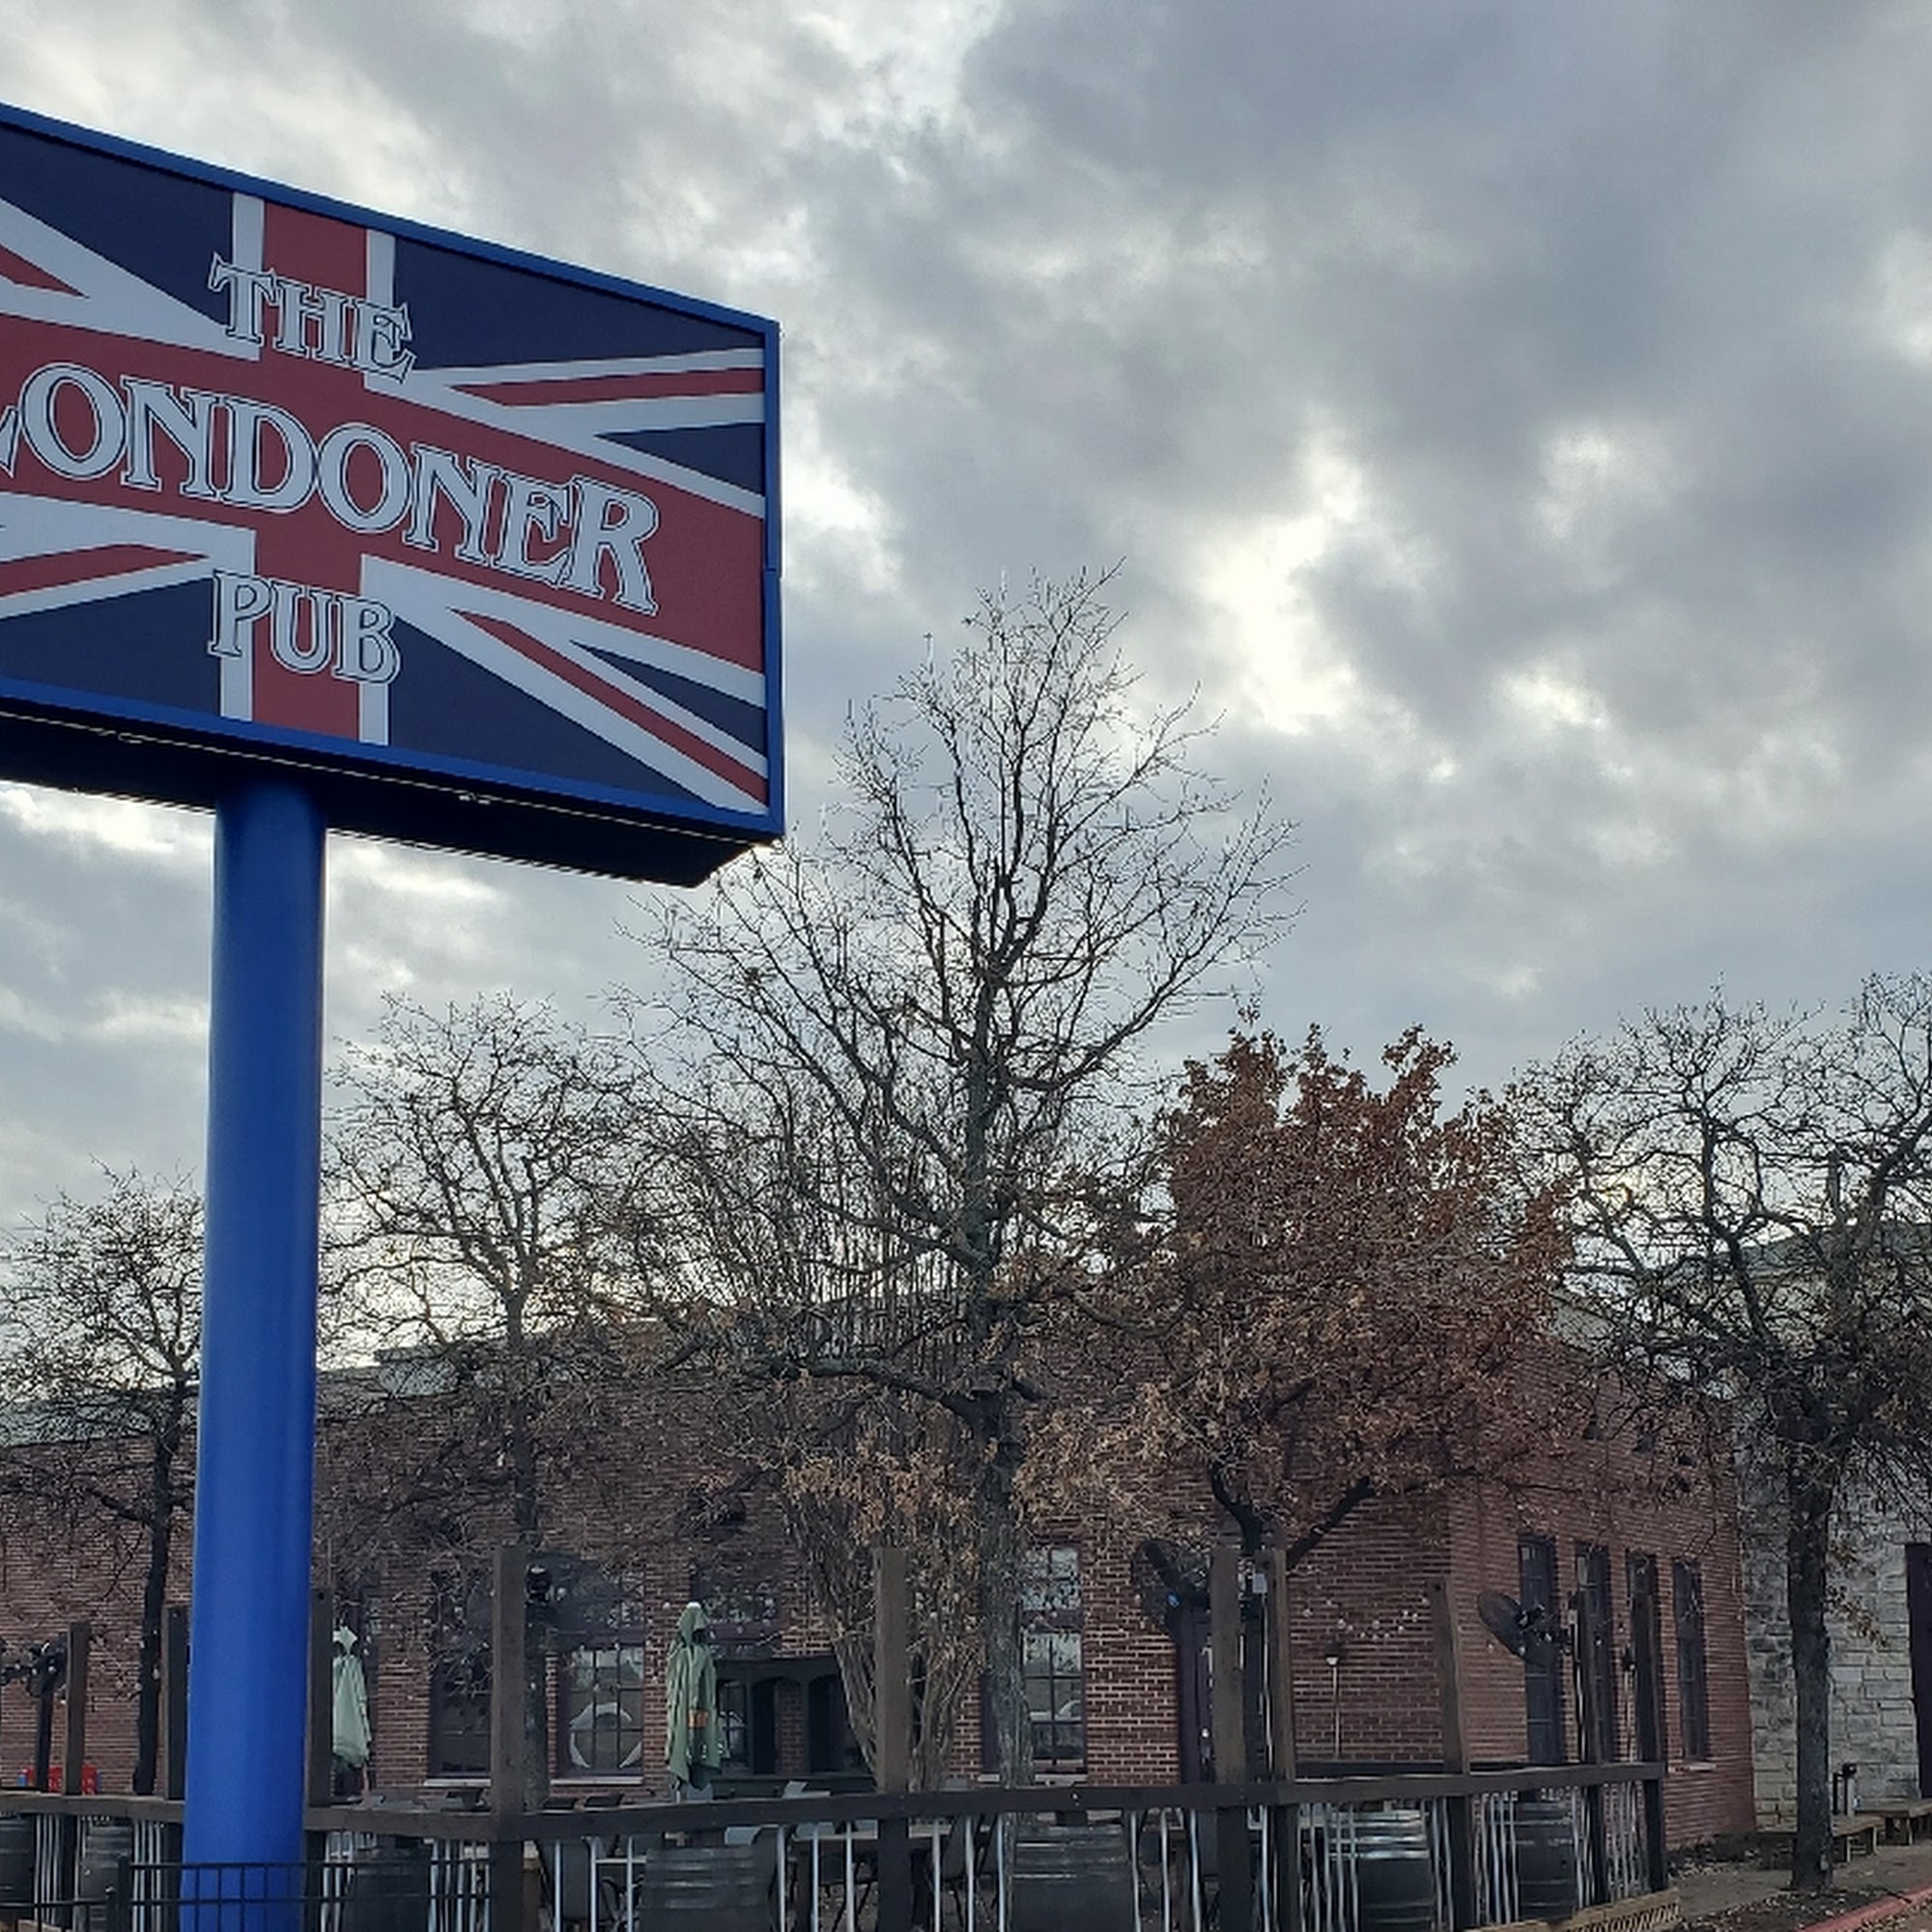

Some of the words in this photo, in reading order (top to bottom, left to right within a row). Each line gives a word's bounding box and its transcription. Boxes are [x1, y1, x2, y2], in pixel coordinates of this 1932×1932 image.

[208, 252, 416, 384] THE
[0, 362, 659, 615] ONDONER
[208, 570, 401, 683] PUB
